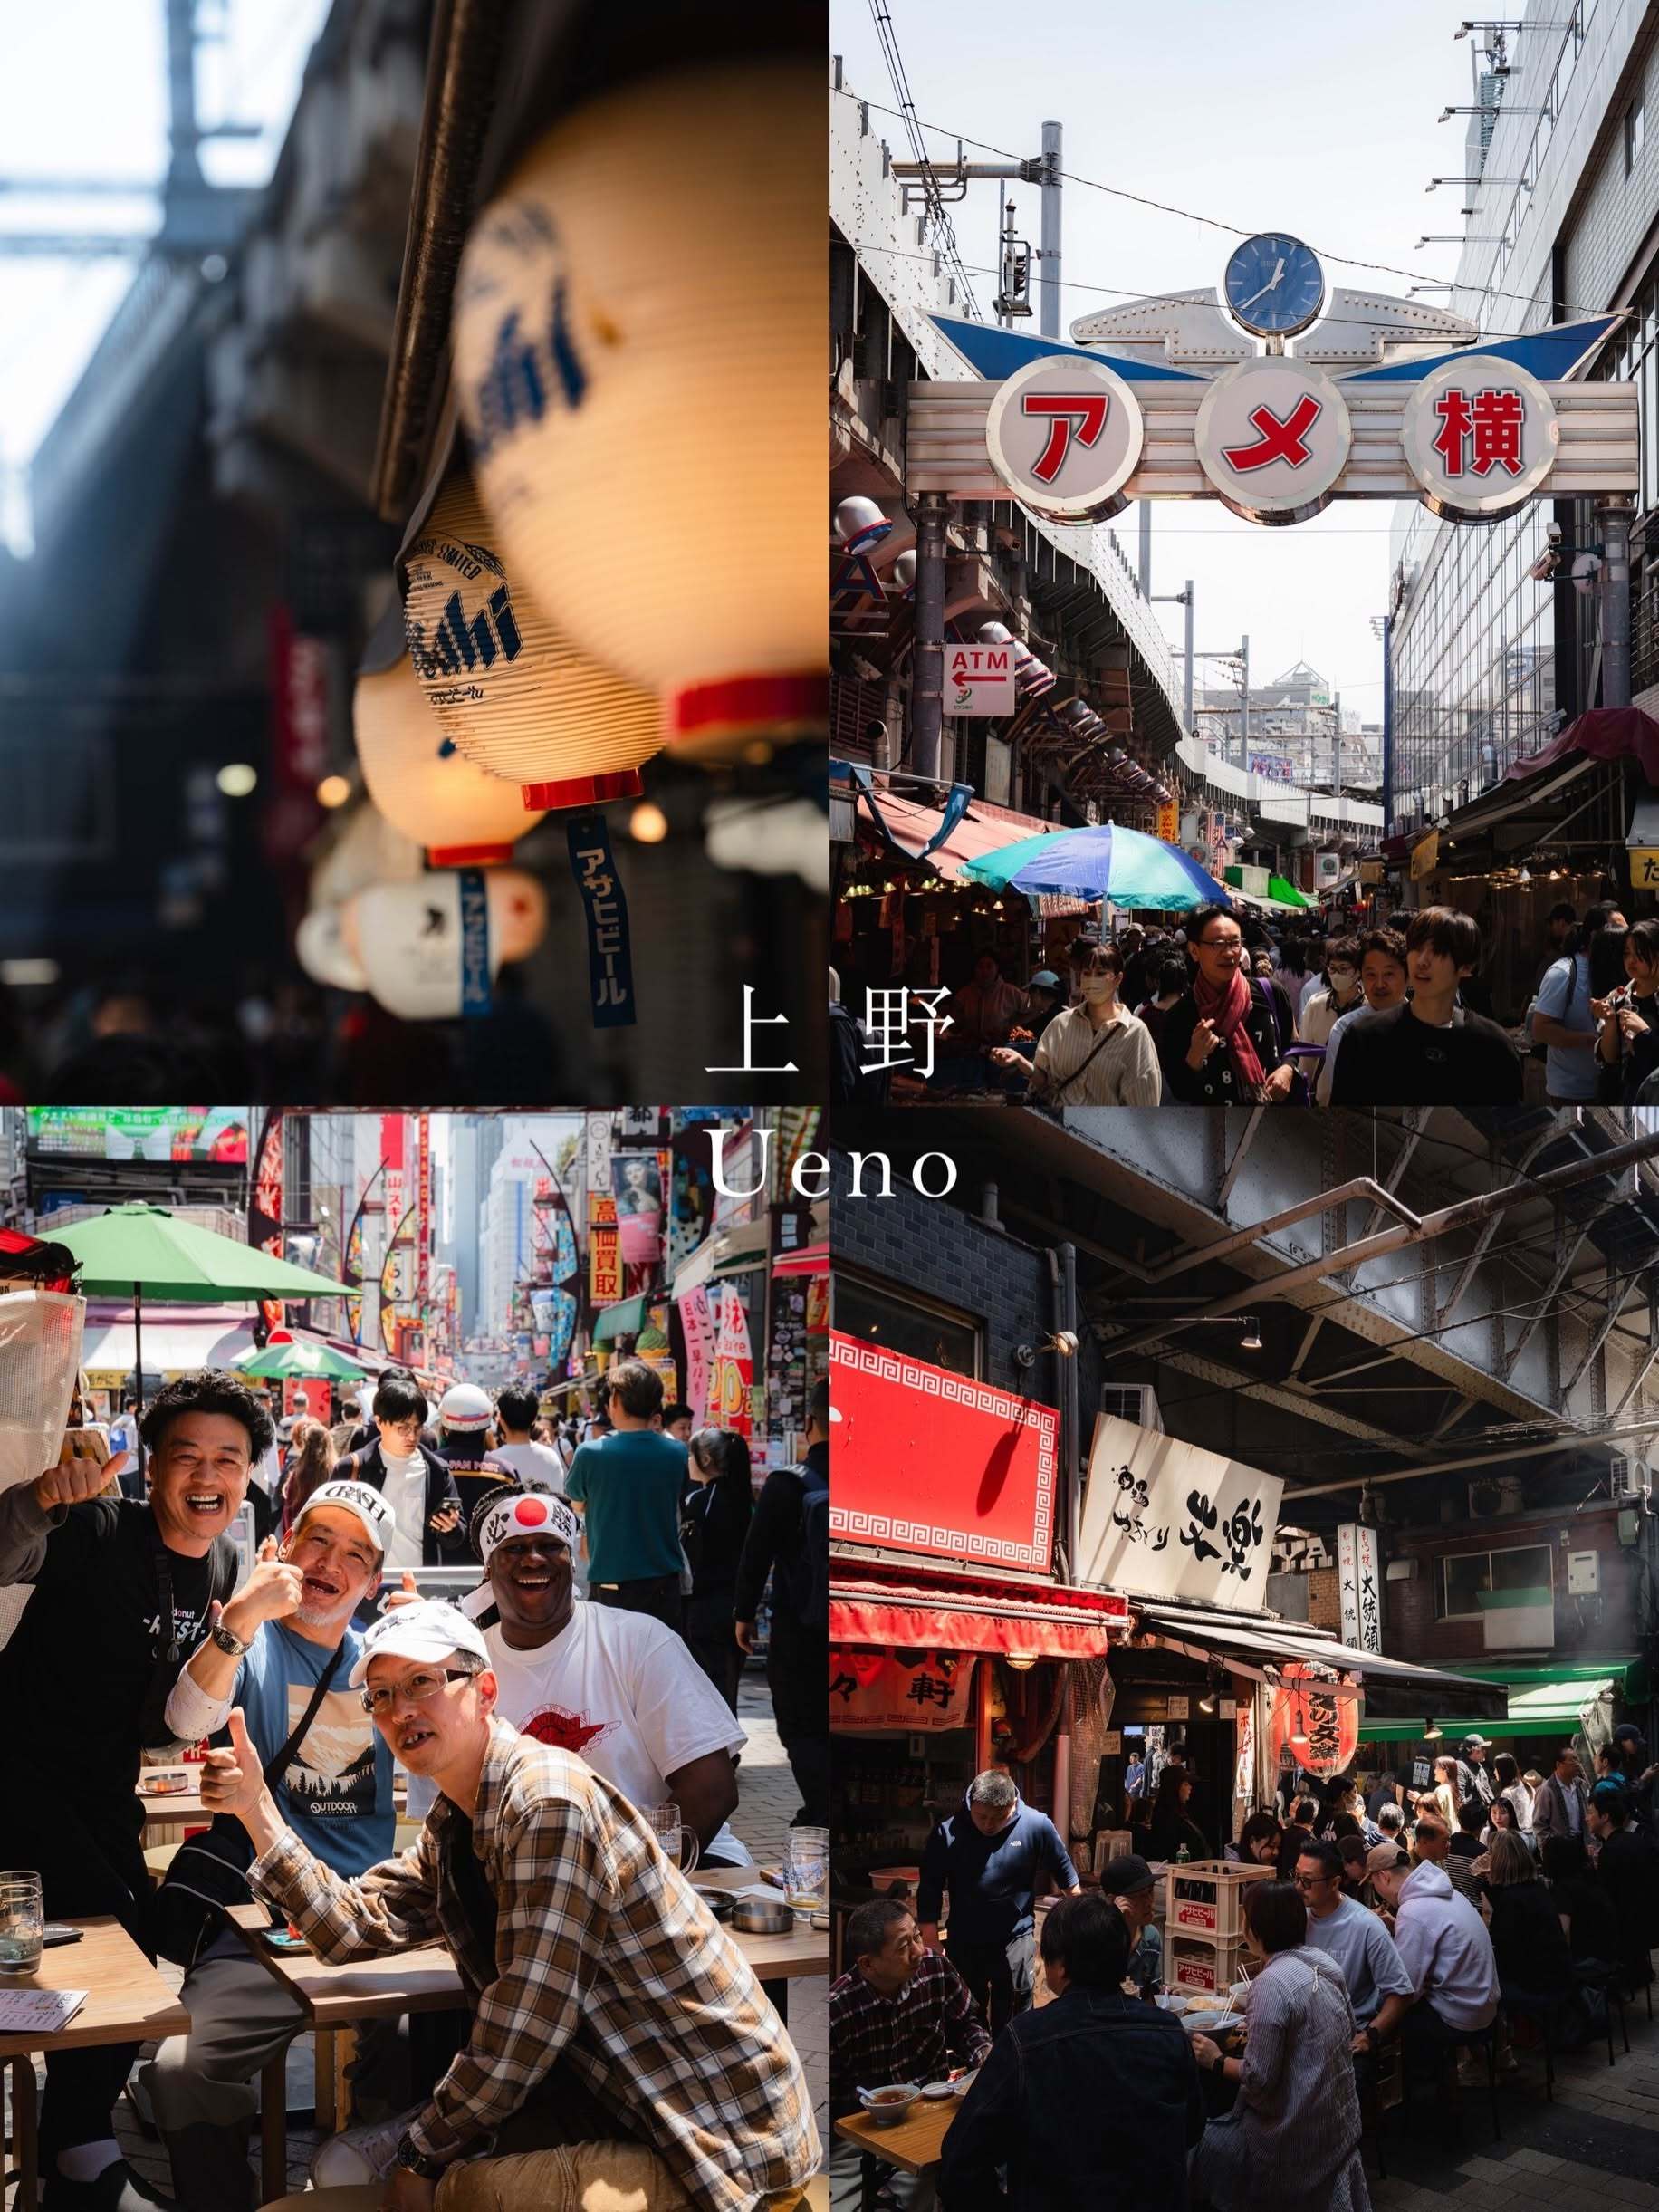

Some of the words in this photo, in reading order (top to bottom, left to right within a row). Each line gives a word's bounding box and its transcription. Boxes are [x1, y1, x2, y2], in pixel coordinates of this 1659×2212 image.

[1022, 389, 1525, 485] アメ横
[951, 651, 1008, 670] ATM
[576, 848, 628, 1007] アサヒビール
[1222, 1070, 1232, 1084] 8
[1361, 1570, 1379, 1653] 大統領
[310, 1801, 358, 1814] OUTDOOR
[1178, 1963, 1215, 1980] アサヒビール
